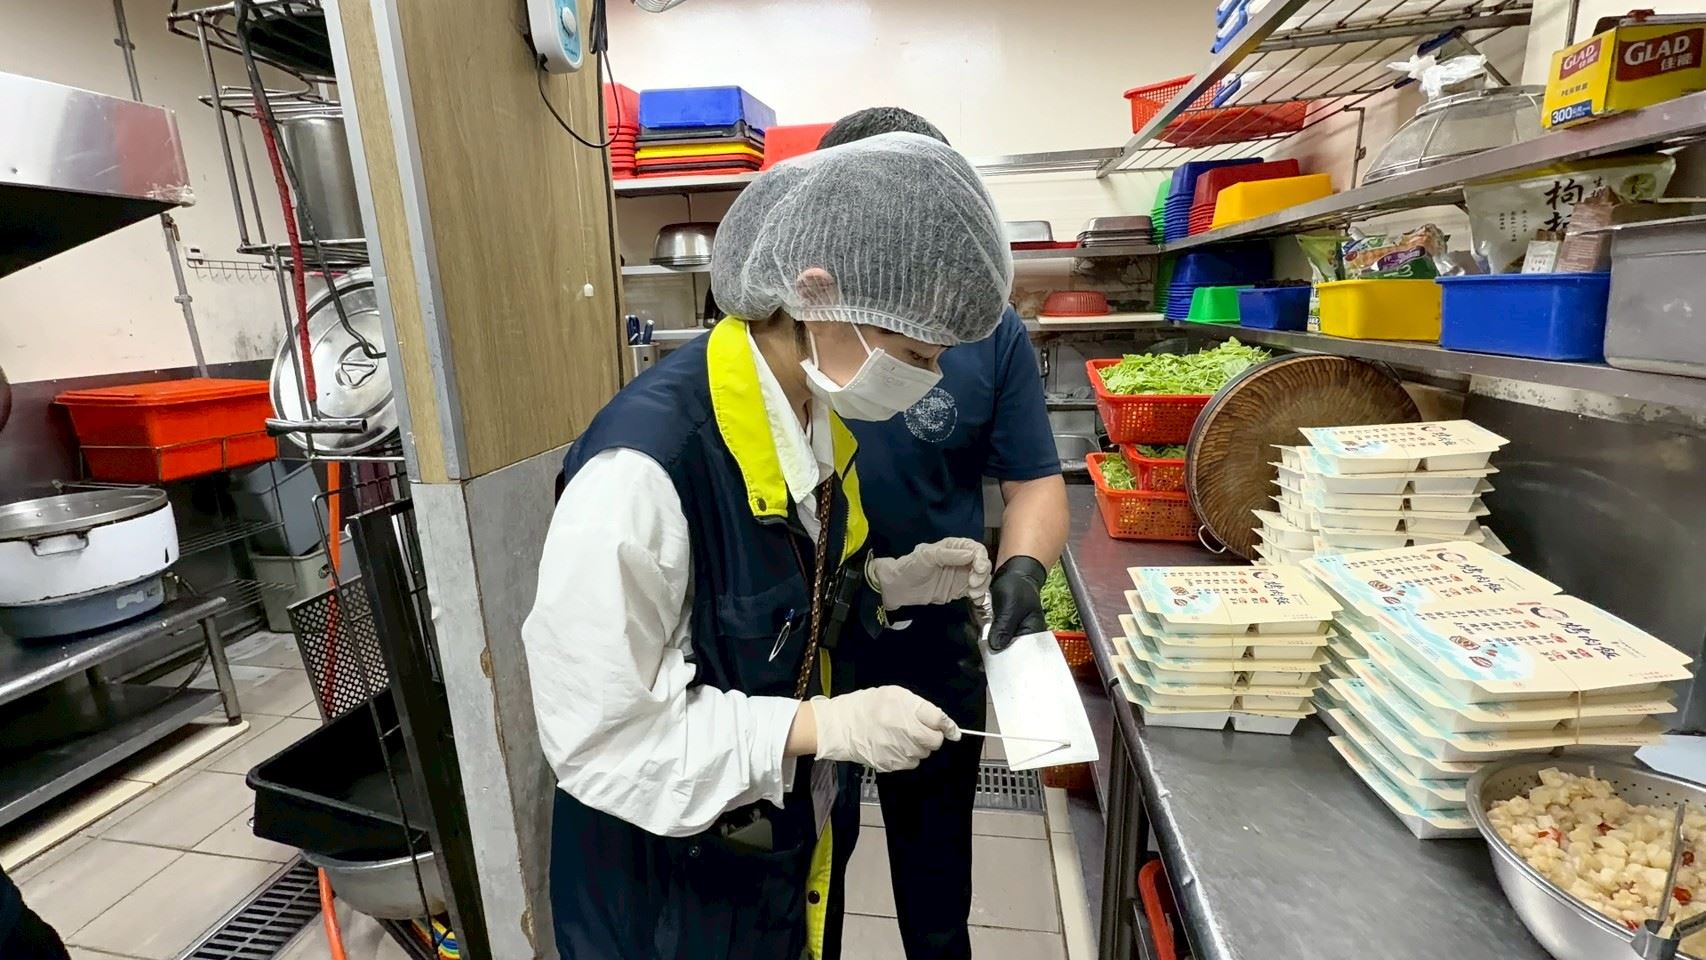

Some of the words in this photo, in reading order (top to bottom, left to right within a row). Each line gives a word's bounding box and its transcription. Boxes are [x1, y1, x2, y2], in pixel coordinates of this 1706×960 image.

[1564, 45, 1594, 70] GLAD
[1624, 36, 1690, 66] GLAD
[1552, 107, 1573, 124] 300
[1558, 622, 1620, 660] 烤肉飯
